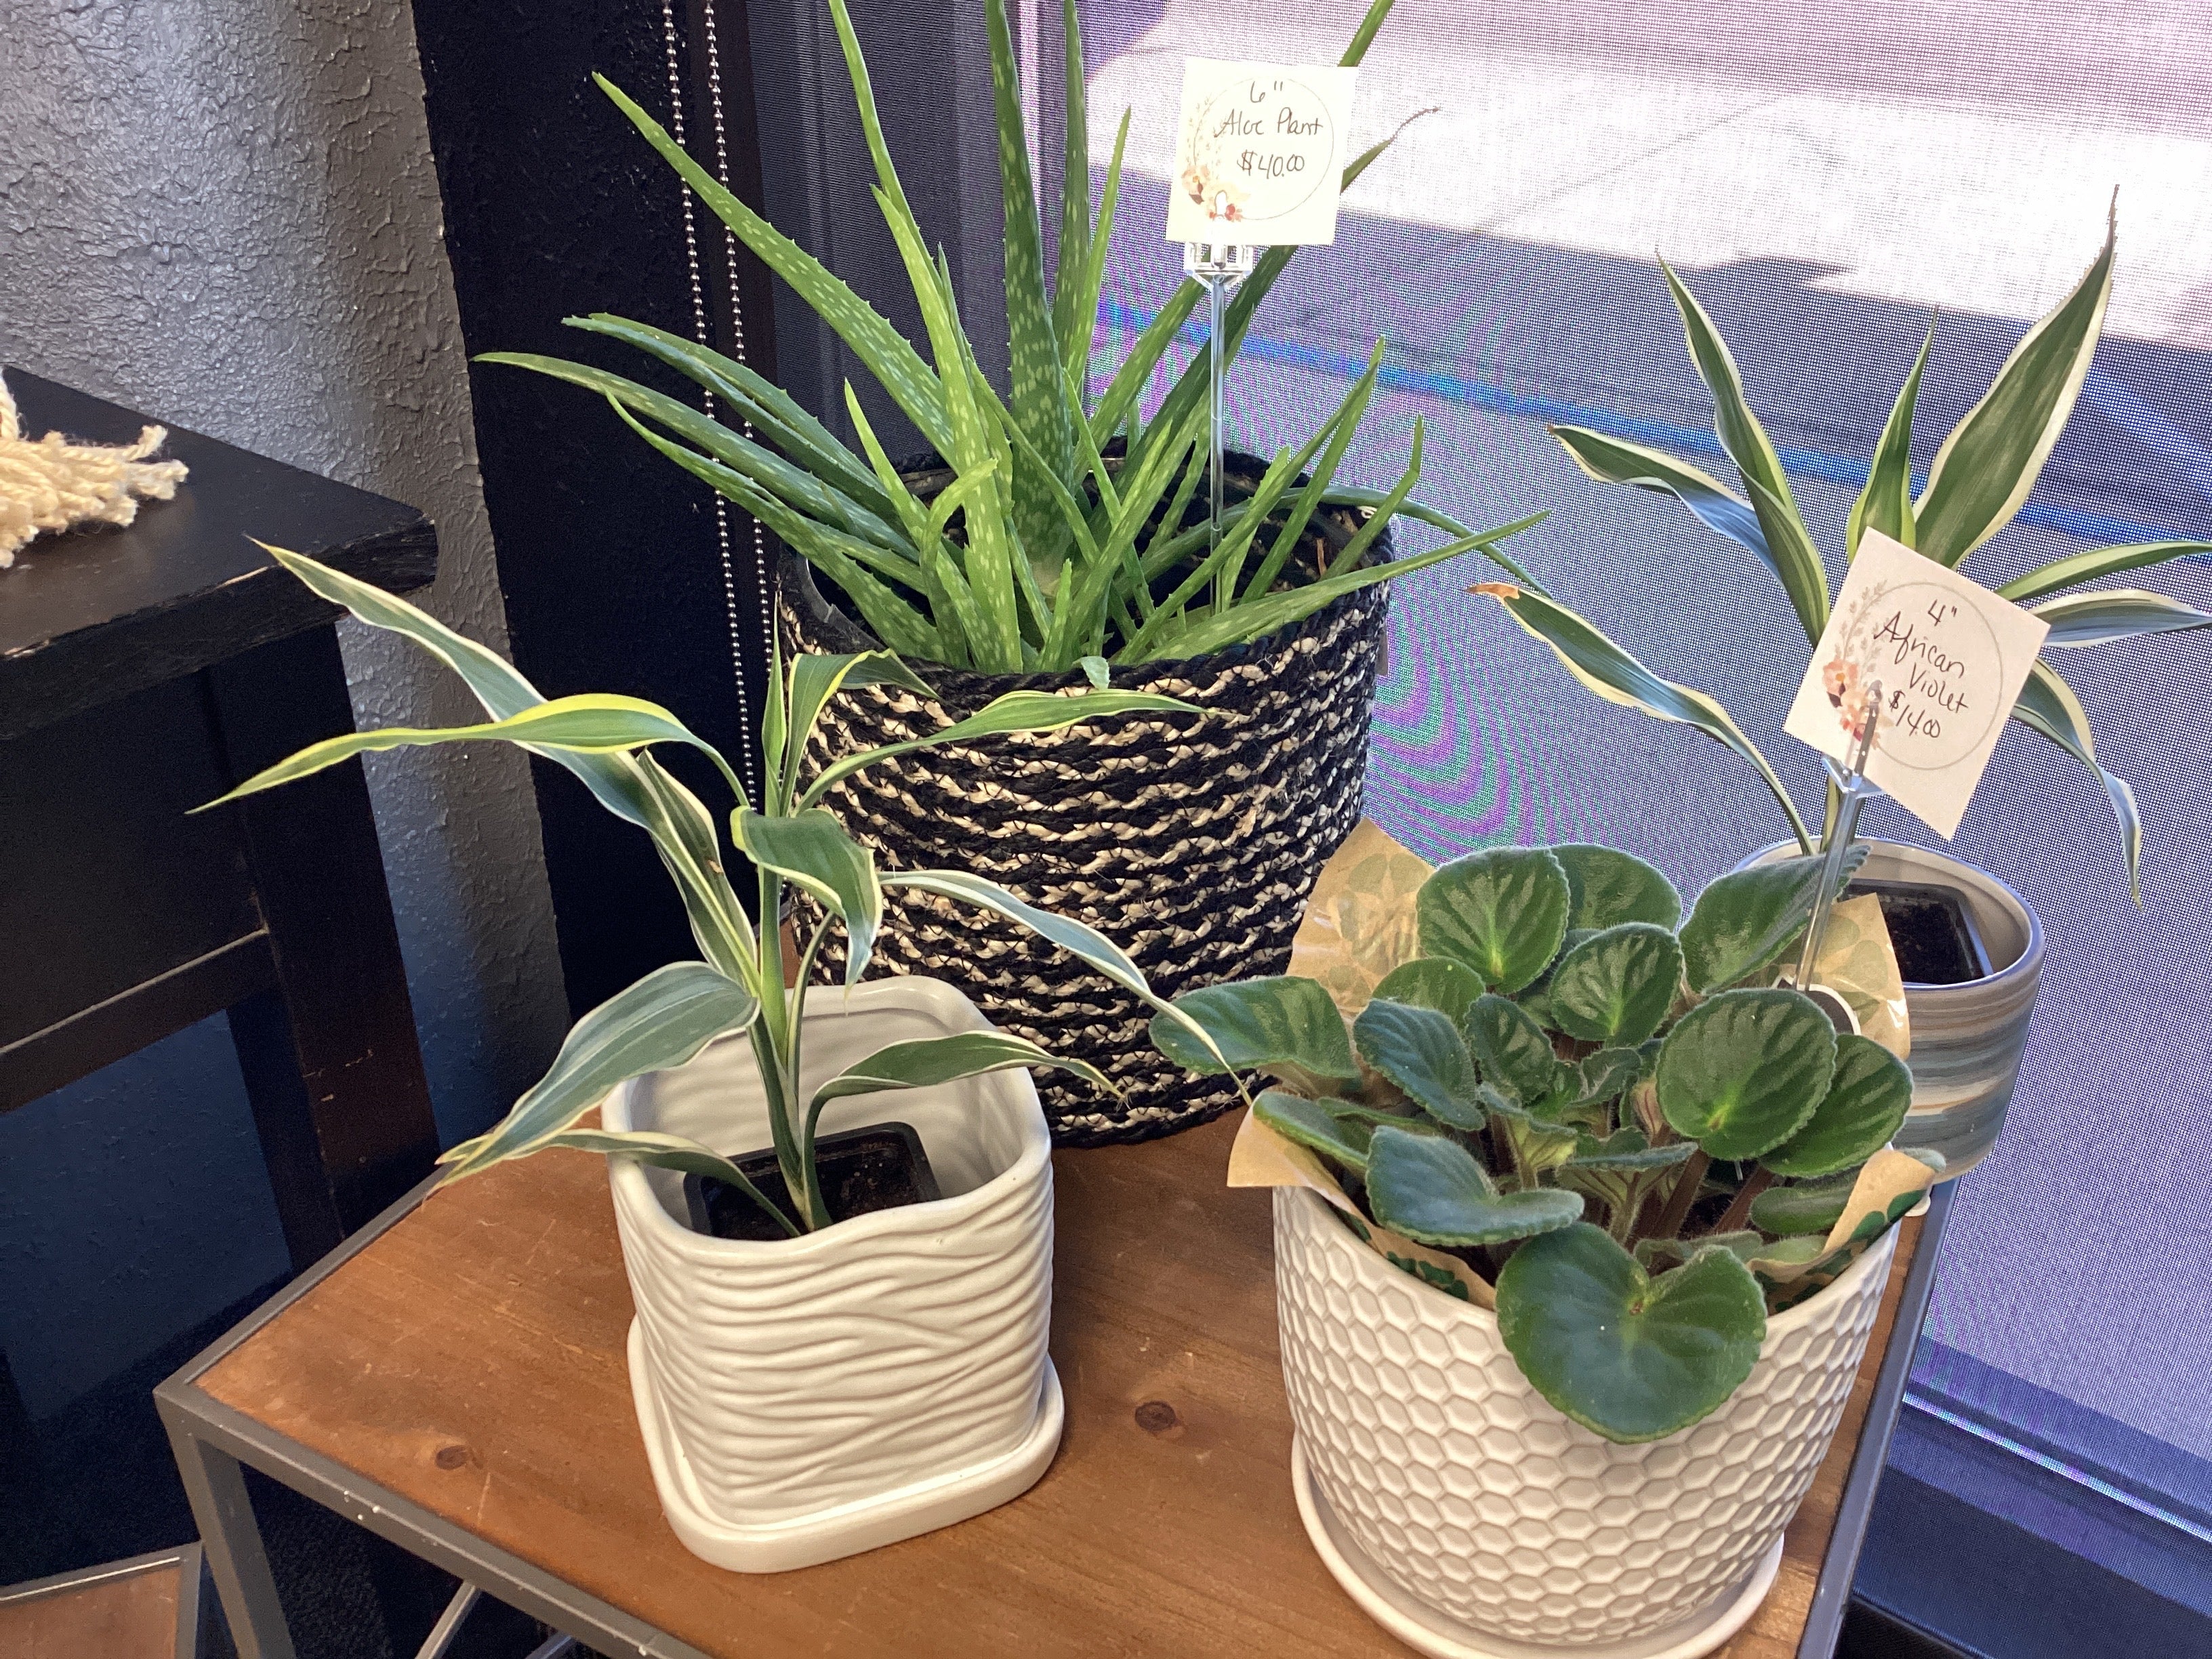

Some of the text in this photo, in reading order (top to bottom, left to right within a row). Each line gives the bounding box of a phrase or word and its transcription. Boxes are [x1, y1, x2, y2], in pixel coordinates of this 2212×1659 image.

[1250, 80, 1284, 103] 6"
[1213, 106, 1324, 138] Aloe Plant
[1237, 149, 1305, 179] $40.00
[1927, 599, 1958, 626] 4"
[1873, 611, 1965, 678] African
[1908, 661, 1969, 714] Violet
[1888, 689, 1941, 738] $14.00
